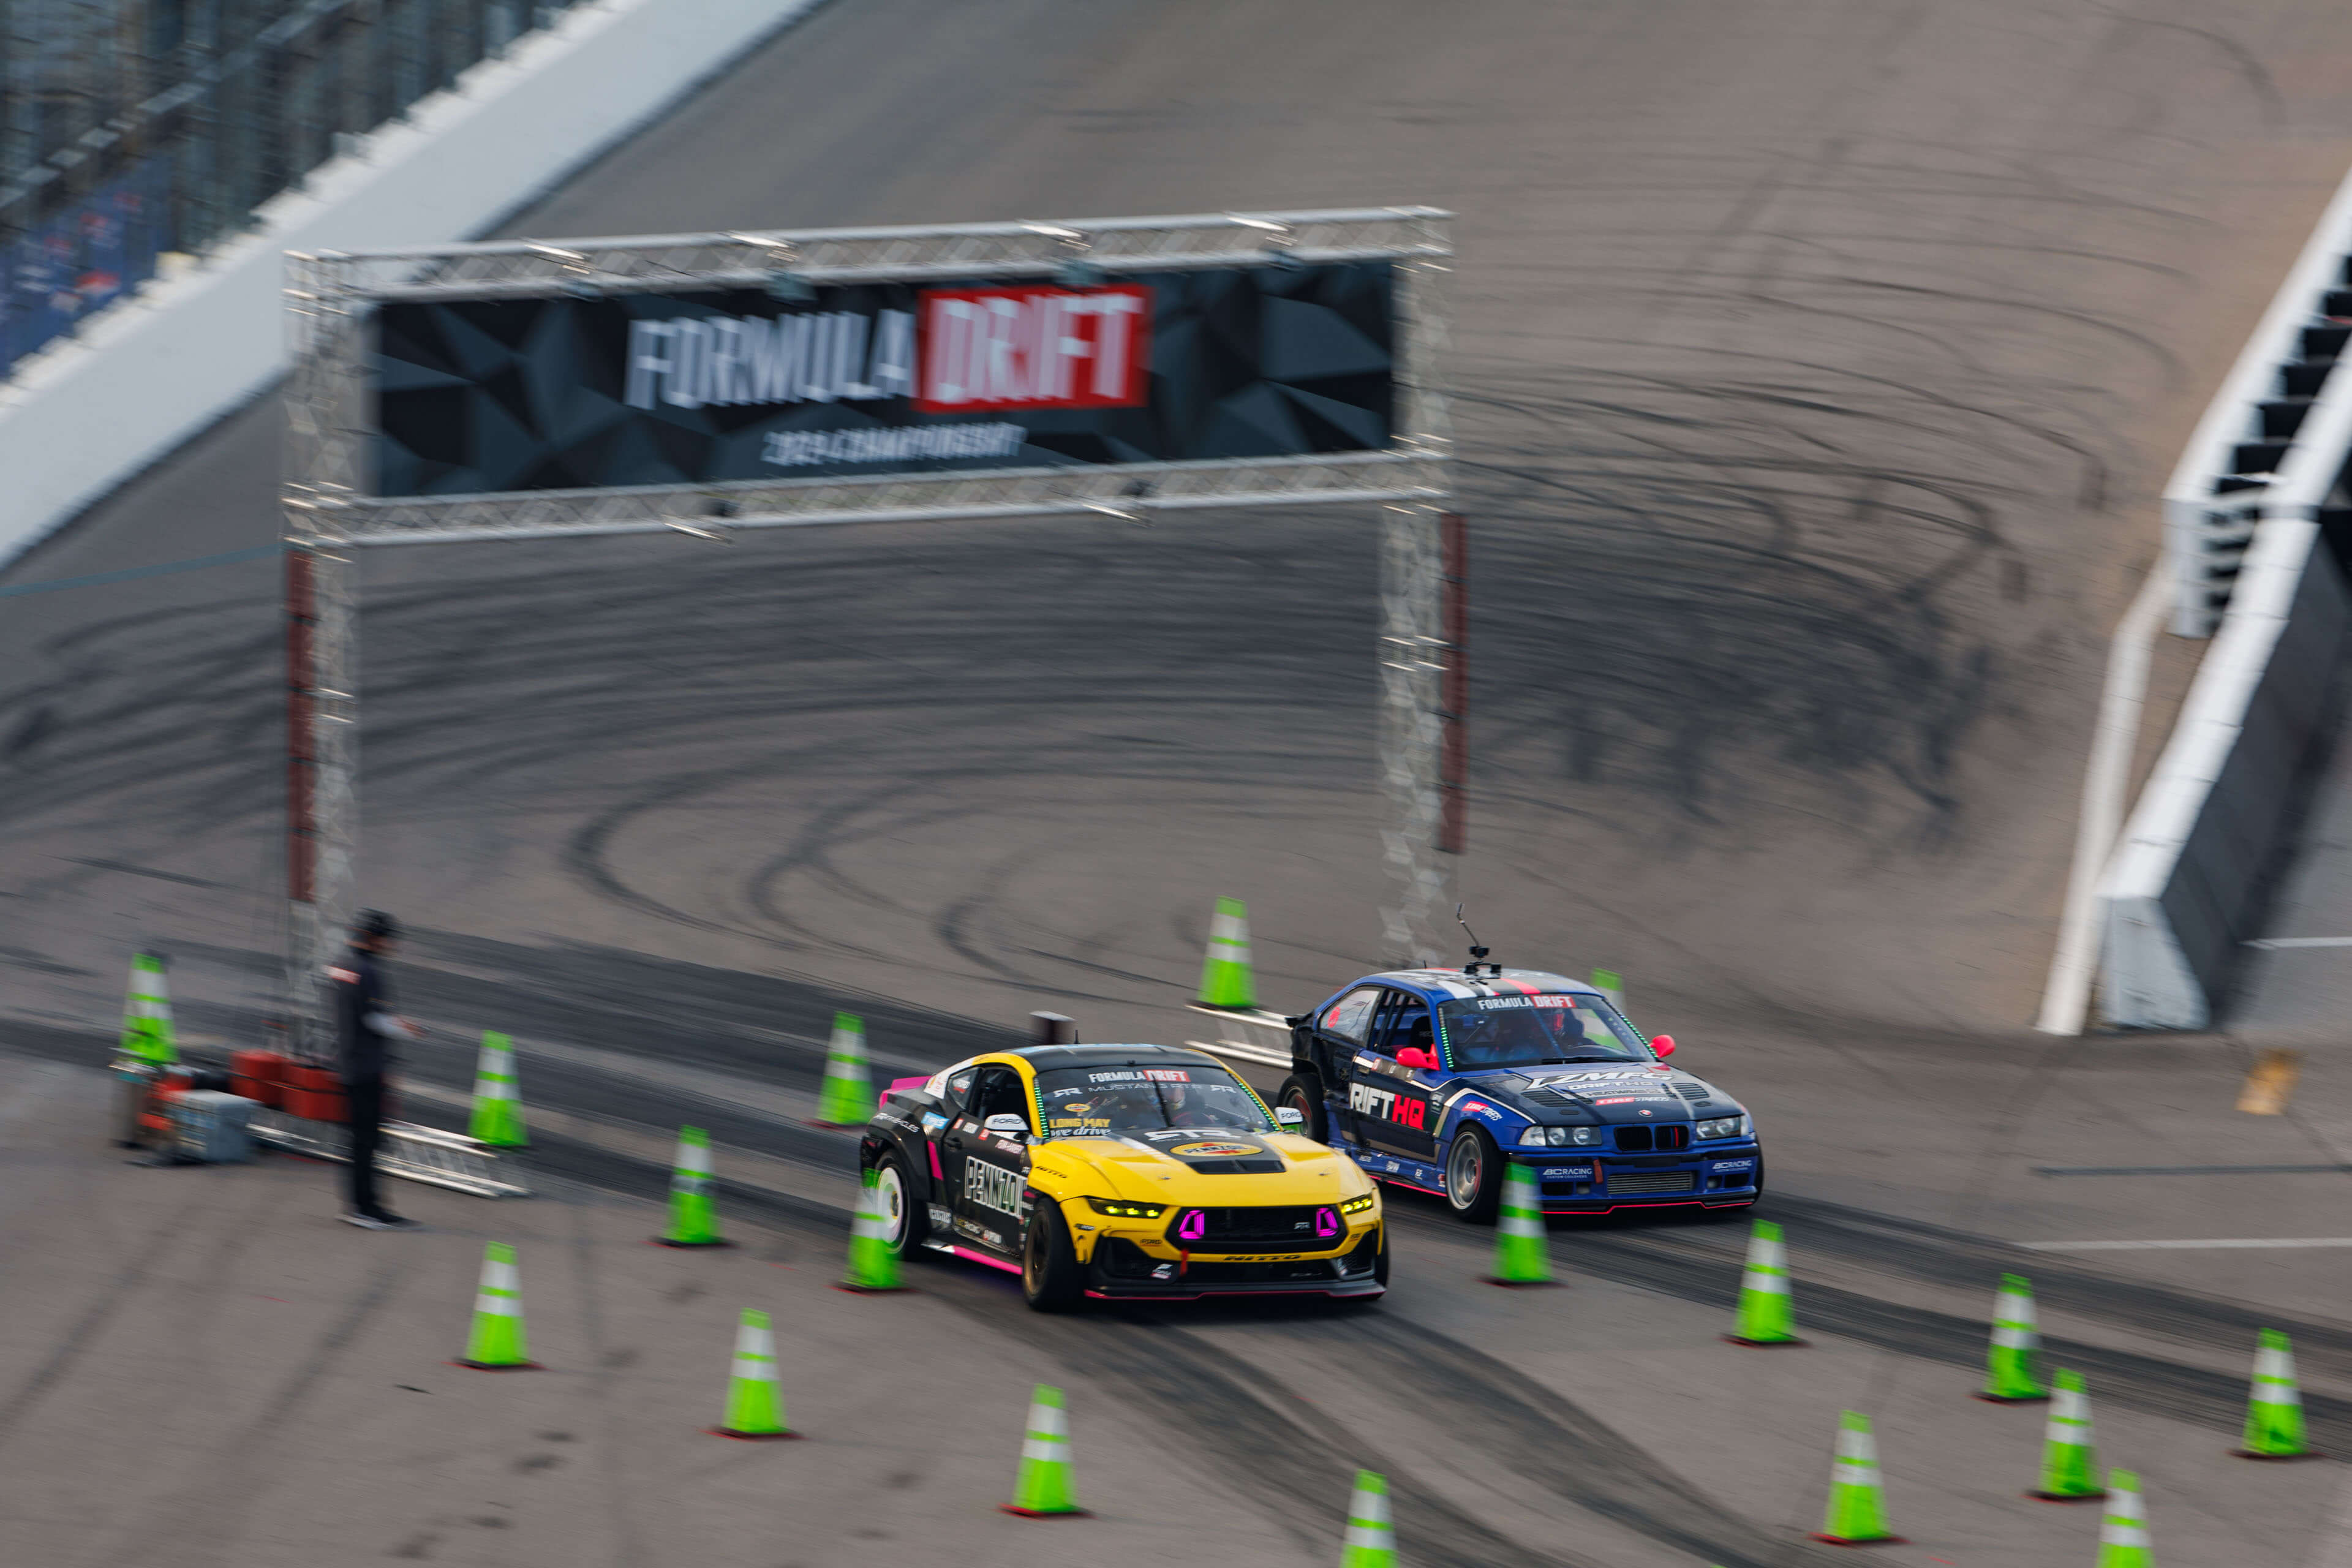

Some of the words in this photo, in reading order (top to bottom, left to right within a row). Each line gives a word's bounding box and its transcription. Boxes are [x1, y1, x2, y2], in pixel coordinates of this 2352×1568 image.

[625, 309, 918, 410] FORMULA
[924, 292, 1144, 405] DRIFT
[1477, 997, 1534, 1010] FORMULA
[1533, 996, 1573, 1008] DRIFT
[1088, 1071, 1145, 1083] FORMULA
[1145, 1070, 1186, 1082] DRIFT
[1525, 1072, 1676, 1090] LZMFG
[1088, 1083, 1167, 1092] MUSTANG
[1049, 1118, 1082, 1128] LONG
[1083, 1118, 1111, 1128] MAY
[1072, 1126, 1112, 1137] drive
